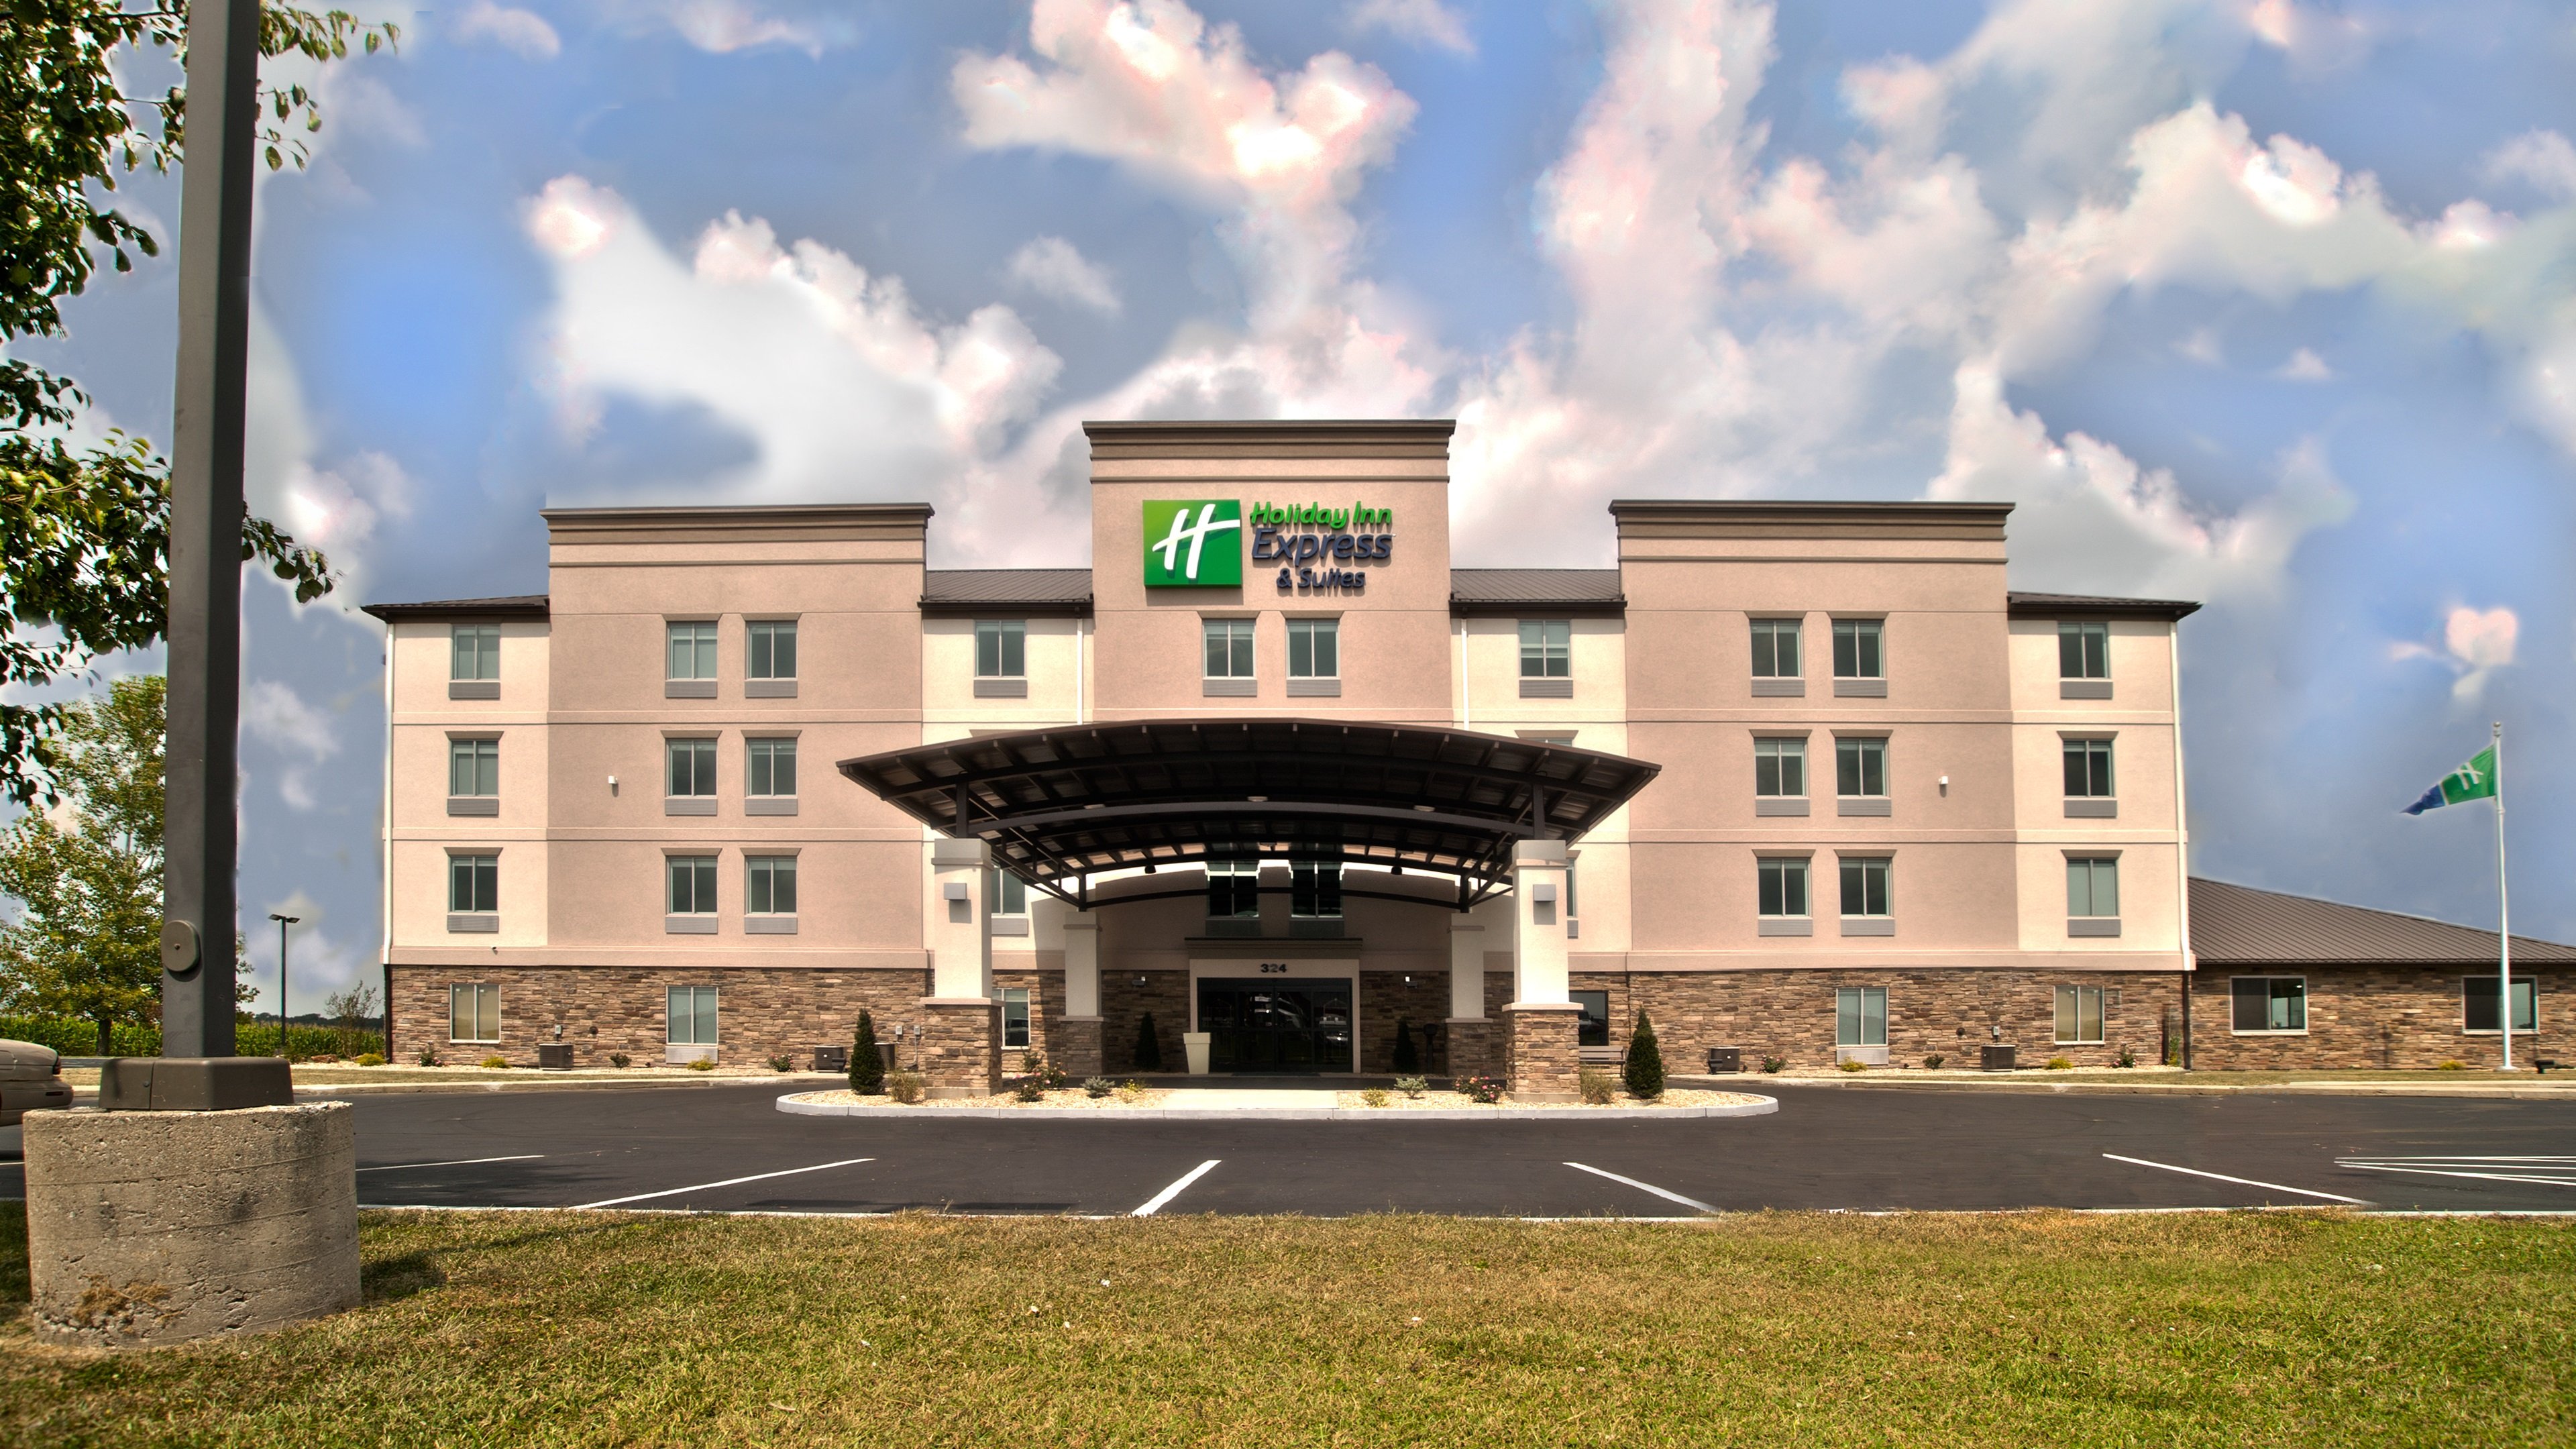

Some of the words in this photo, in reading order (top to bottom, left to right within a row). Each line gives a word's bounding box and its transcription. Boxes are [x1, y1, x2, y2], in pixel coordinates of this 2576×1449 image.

[1250, 501, 1348, 529] Holiday
[1352, 500, 1392, 525] Inn
[1152, 504, 1240, 579] H
[1252, 527, 1393, 568] Express
[1276, 568, 1292, 588] &
[1297, 568, 1365, 588] Suites
[1260, 963, 1287, 973] 324
